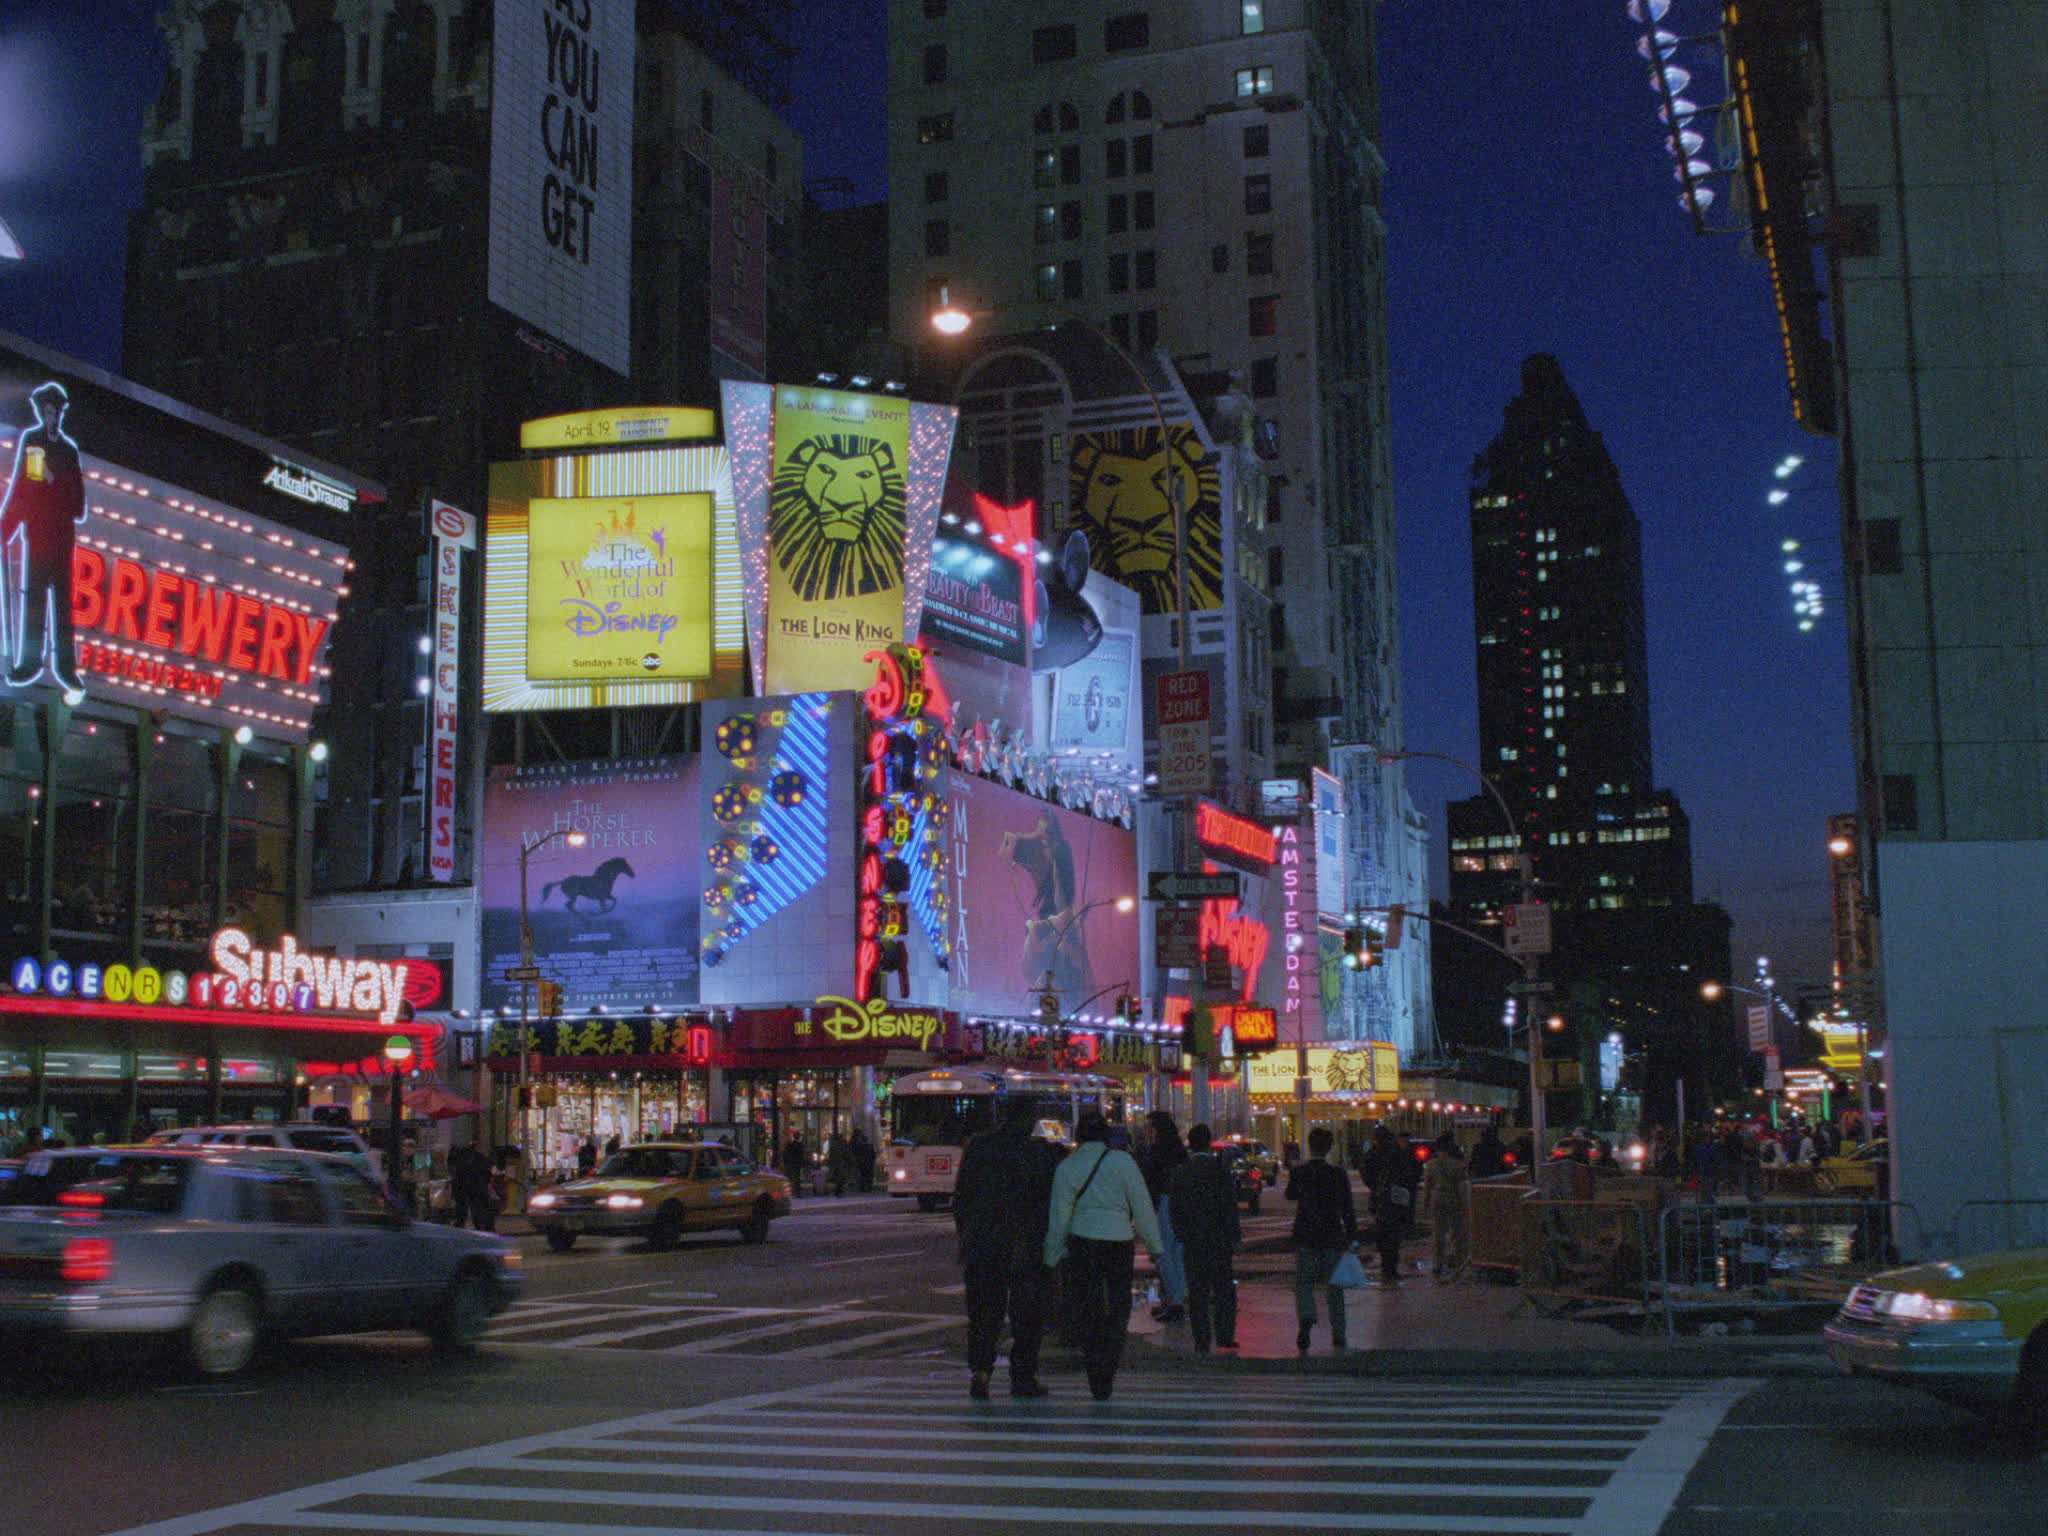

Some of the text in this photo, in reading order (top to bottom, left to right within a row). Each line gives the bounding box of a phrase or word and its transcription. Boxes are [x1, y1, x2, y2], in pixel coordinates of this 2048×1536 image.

[543, 8, 598, 114] YOU
[541, 94, 597, 193] CAN
[541, 174, 595, 266] GET
[564, 420, 610, 440] April 19
[608, 543, 646, 561] The
[928, 571, 968, 606] EAUTY
[71, 545, 328, 685] BREWERY
[781, 615, 893, 642] THE LION KING
[79, 643, 224, 699] RESTAURANT
[573, 658, 613, 669] Sundays
[642, 656, 662, 667] abc
[437, 545, 459, 848] SKECHERS
[1168, 677, 1198, 695] RED
[1165, 700, 1203, 719] ZONE
[553, 811, 630, 833] HORSE
[574, 800, 603, 816] THE
[953, 799, 968, 986] MULAN
[18, 963, 311, 1009] A C E N R S 1 2 3 9 7
[212, 928, 408, 1025] Subway
[1236, 1023, 1275, 1040] WALK
[1252, 1064, 1268, 1074] THE
[1272, 1063, 1296, 1076] LION
